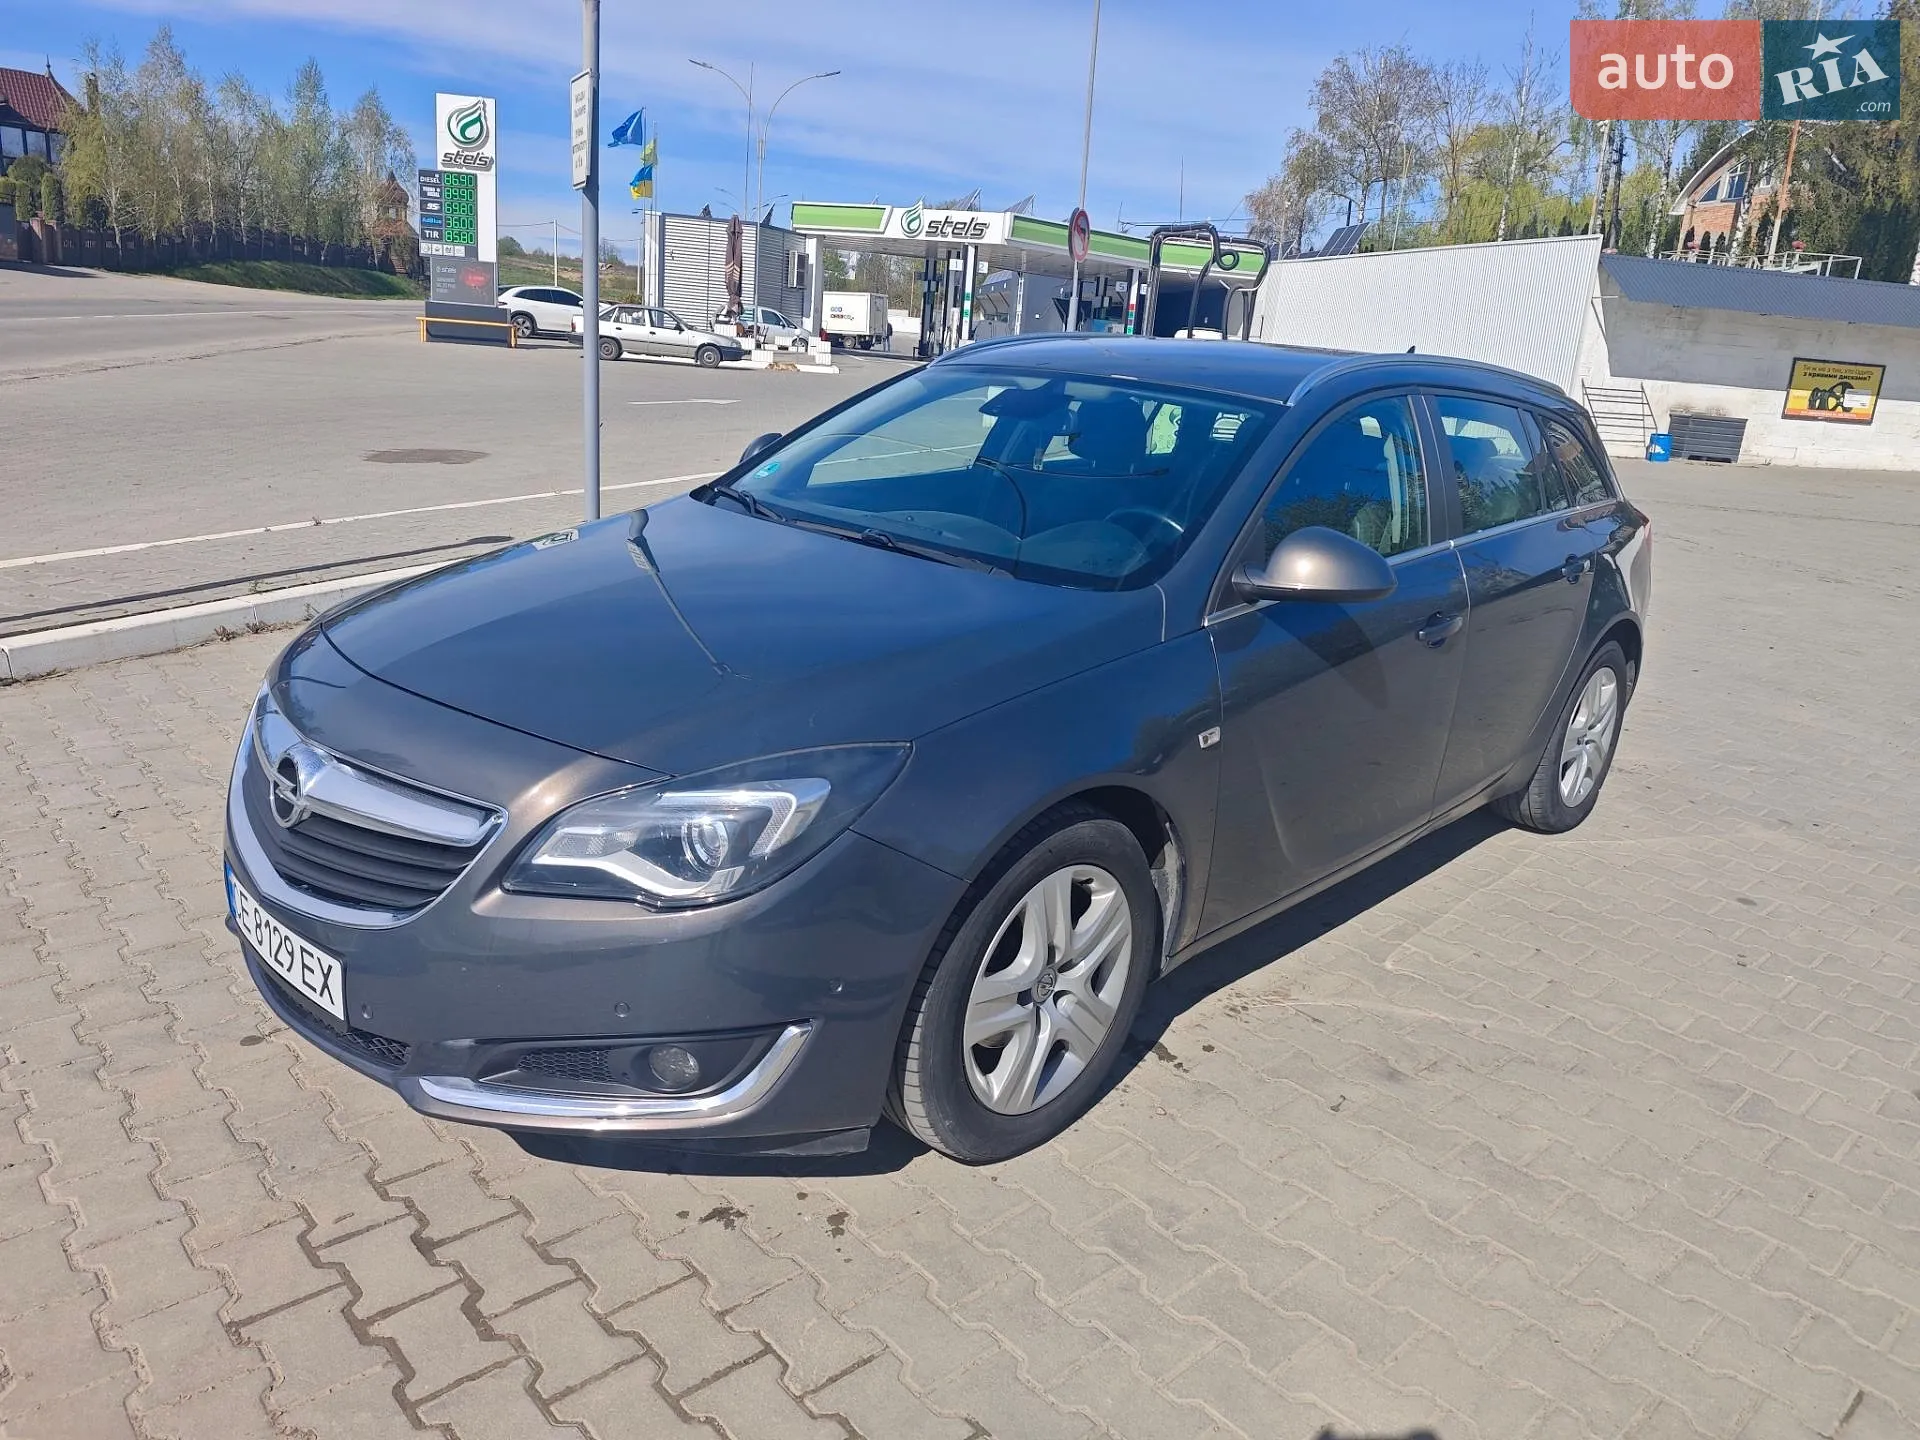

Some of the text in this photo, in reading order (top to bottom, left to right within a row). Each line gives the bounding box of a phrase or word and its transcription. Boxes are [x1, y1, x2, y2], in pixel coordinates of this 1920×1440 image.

[441, 150, 490, 167] stels
[420, 176, 440, 184] DIESEL
[925, 215, 988, 238] stels
[424, 230, 440, 239] TIR
[1808, 372, 1838, 380] кривими
[254, 907, 295, 973] 8129
[300, 944, 335, 1006] EX
